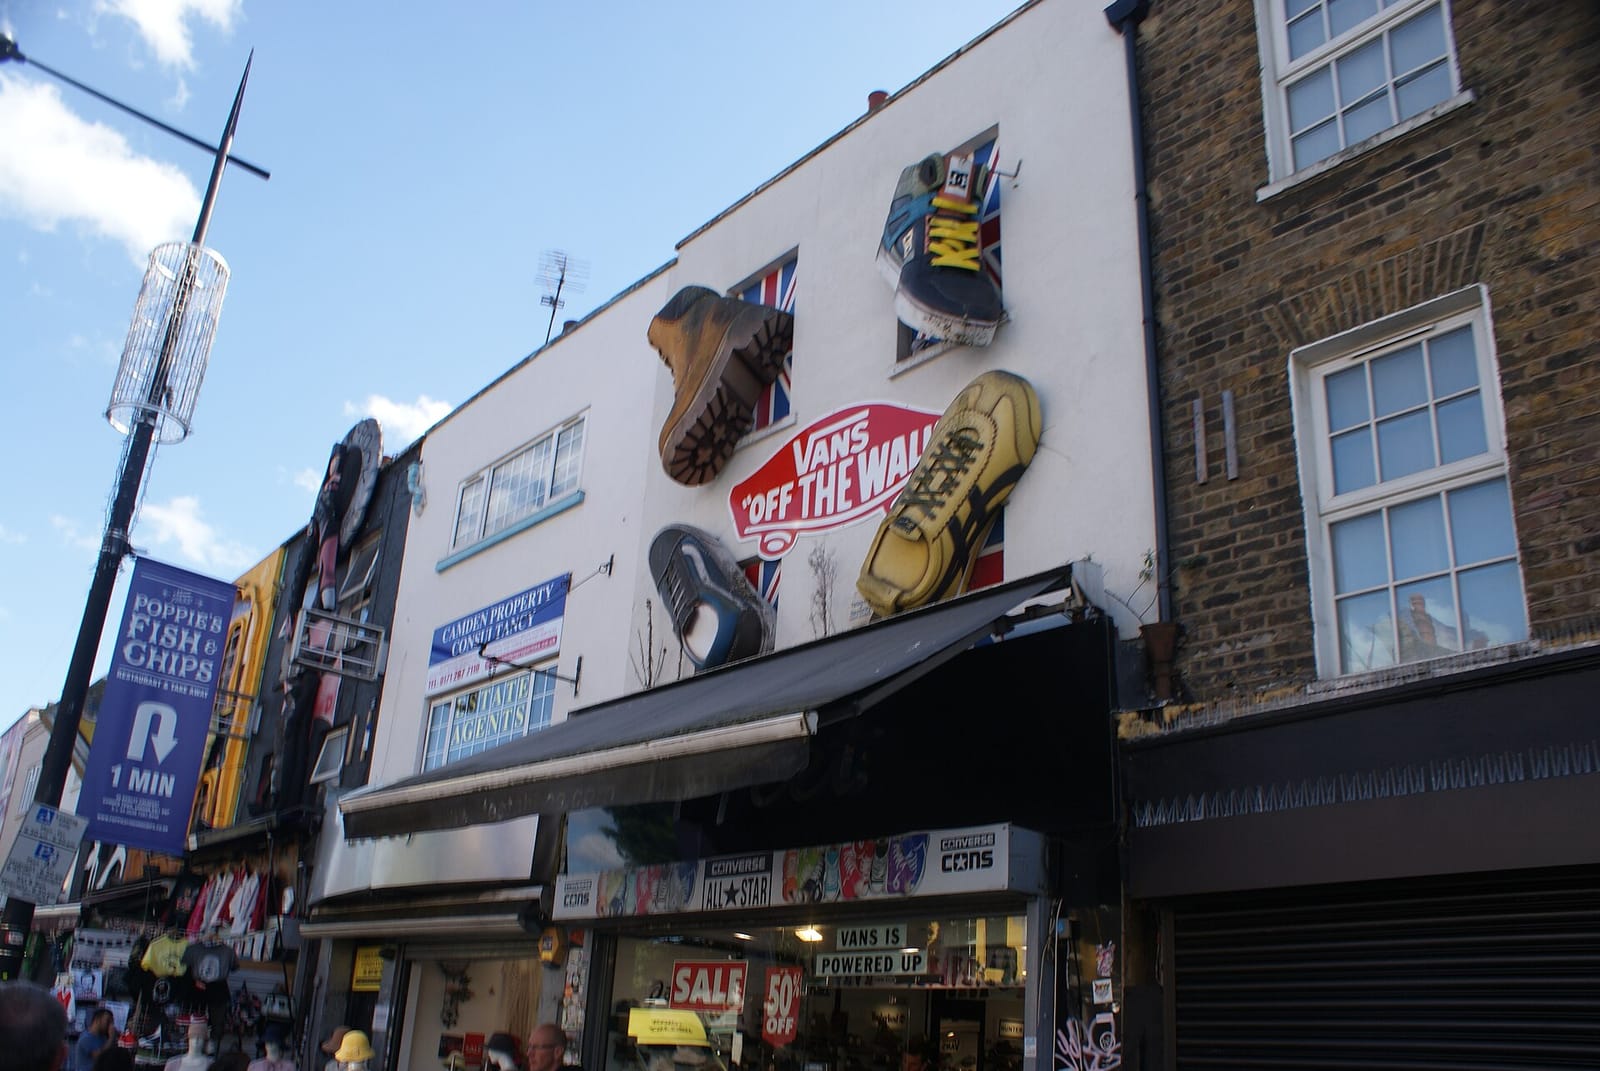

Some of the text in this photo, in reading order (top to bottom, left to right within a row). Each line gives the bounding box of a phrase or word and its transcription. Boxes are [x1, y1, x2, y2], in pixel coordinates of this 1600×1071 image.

[792, 409, 869, 477] VANS
[799, 454, 853, 519] THE
[133, 592, 222, 633] POPPIE'S
[442, 584, 554, 644] CAMDEN PROPERTY
[451, 609, 537, 656] CONSULTANCY
[126, 612, 217, 655] FISH &
[116, 671, 161, 688] RESTAURANT
[123, 640, 213, 683] CHIPS
[455, 675, 529, 718] ESTATE
[450, 704, 525, 746] AGENTS
[111, 763, 175, 798] 1 MIN
[712, 856, 766, 876] CONVERSE
[941, 850, 993, 873] CONS
[706, 877, 767, 909] ALL STAR
[841, 927, 900, 947] VANS IS
[821, 954, 922, 974] POWERED UP
[674, 967, 743, 1006] SALE
[766, 973, 801, 1018] 50%
[766, 1017, 794, 1035] OFF
